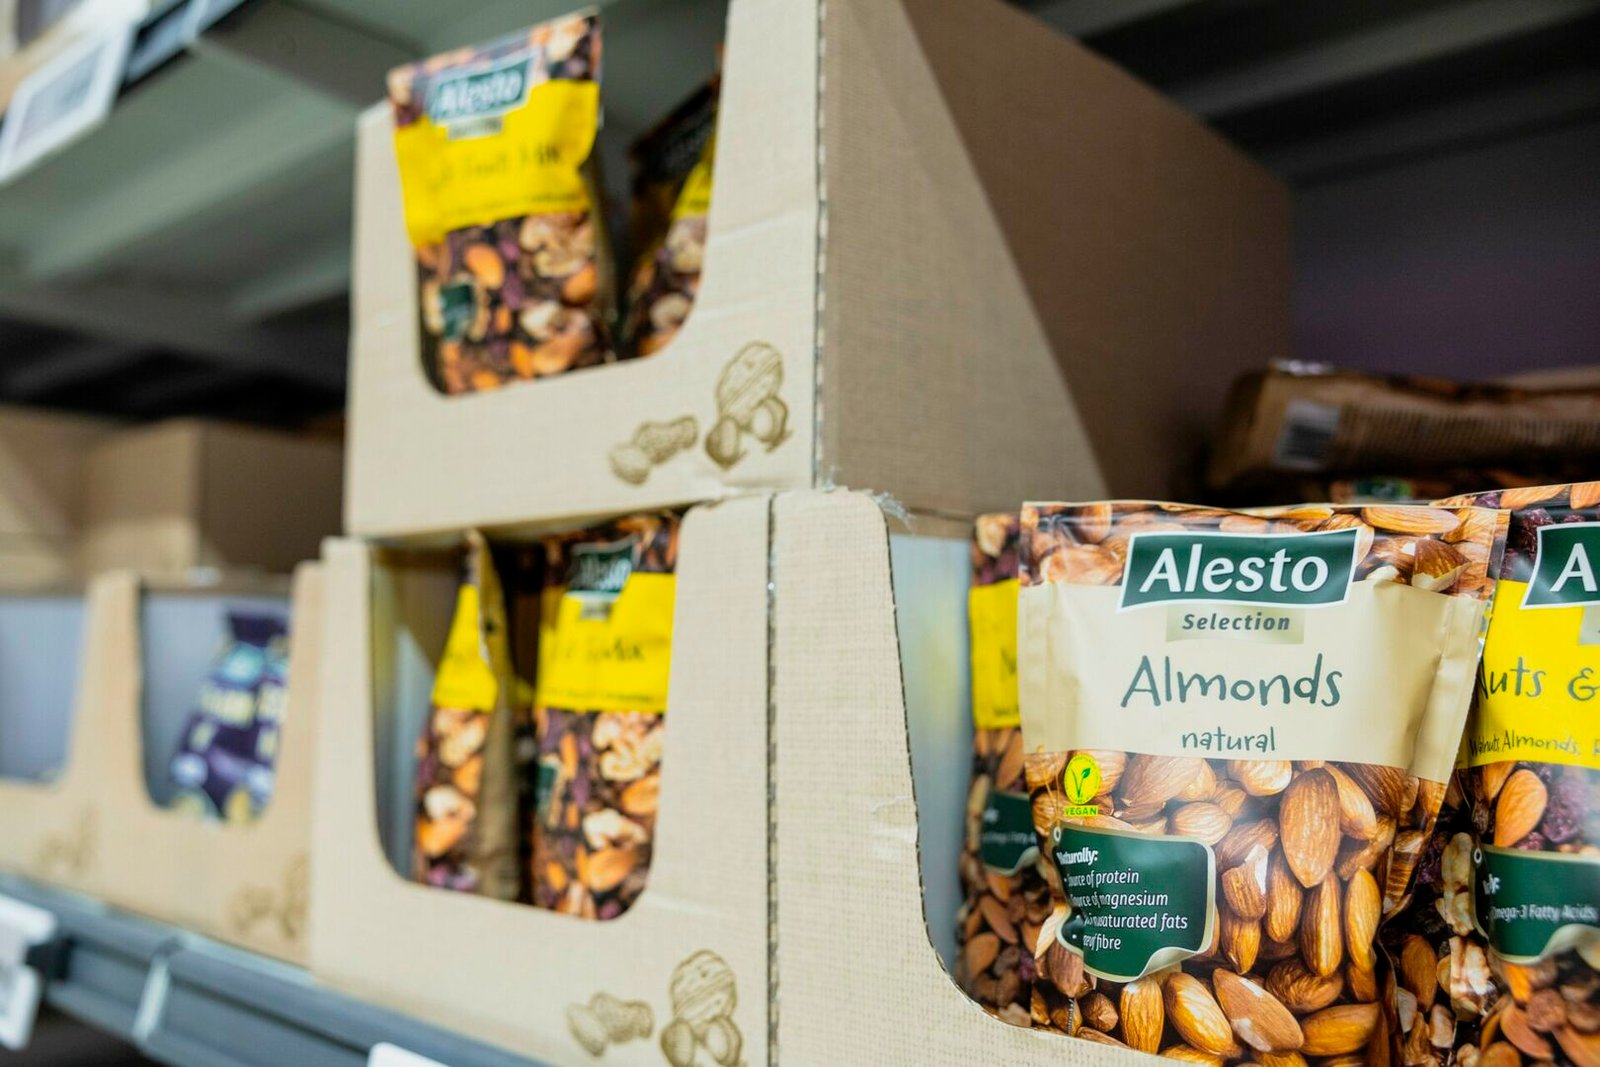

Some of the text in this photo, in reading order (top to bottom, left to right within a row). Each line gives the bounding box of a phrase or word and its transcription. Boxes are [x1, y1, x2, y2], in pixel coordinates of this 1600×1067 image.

[1139, 543, 1329, 593] Alesto
[1182, 613, 1291, 631] Selection
[1120, 653, 1343, 708] Almonds
[1182, 726, 1276, 752] natural
[1065, 807, 1097, 815] VEGAN
[1096, 868, 1139, 888] protein
[1100, 890, 1168, 910] magnesium
[1160, 913, 1188, 933] fats
